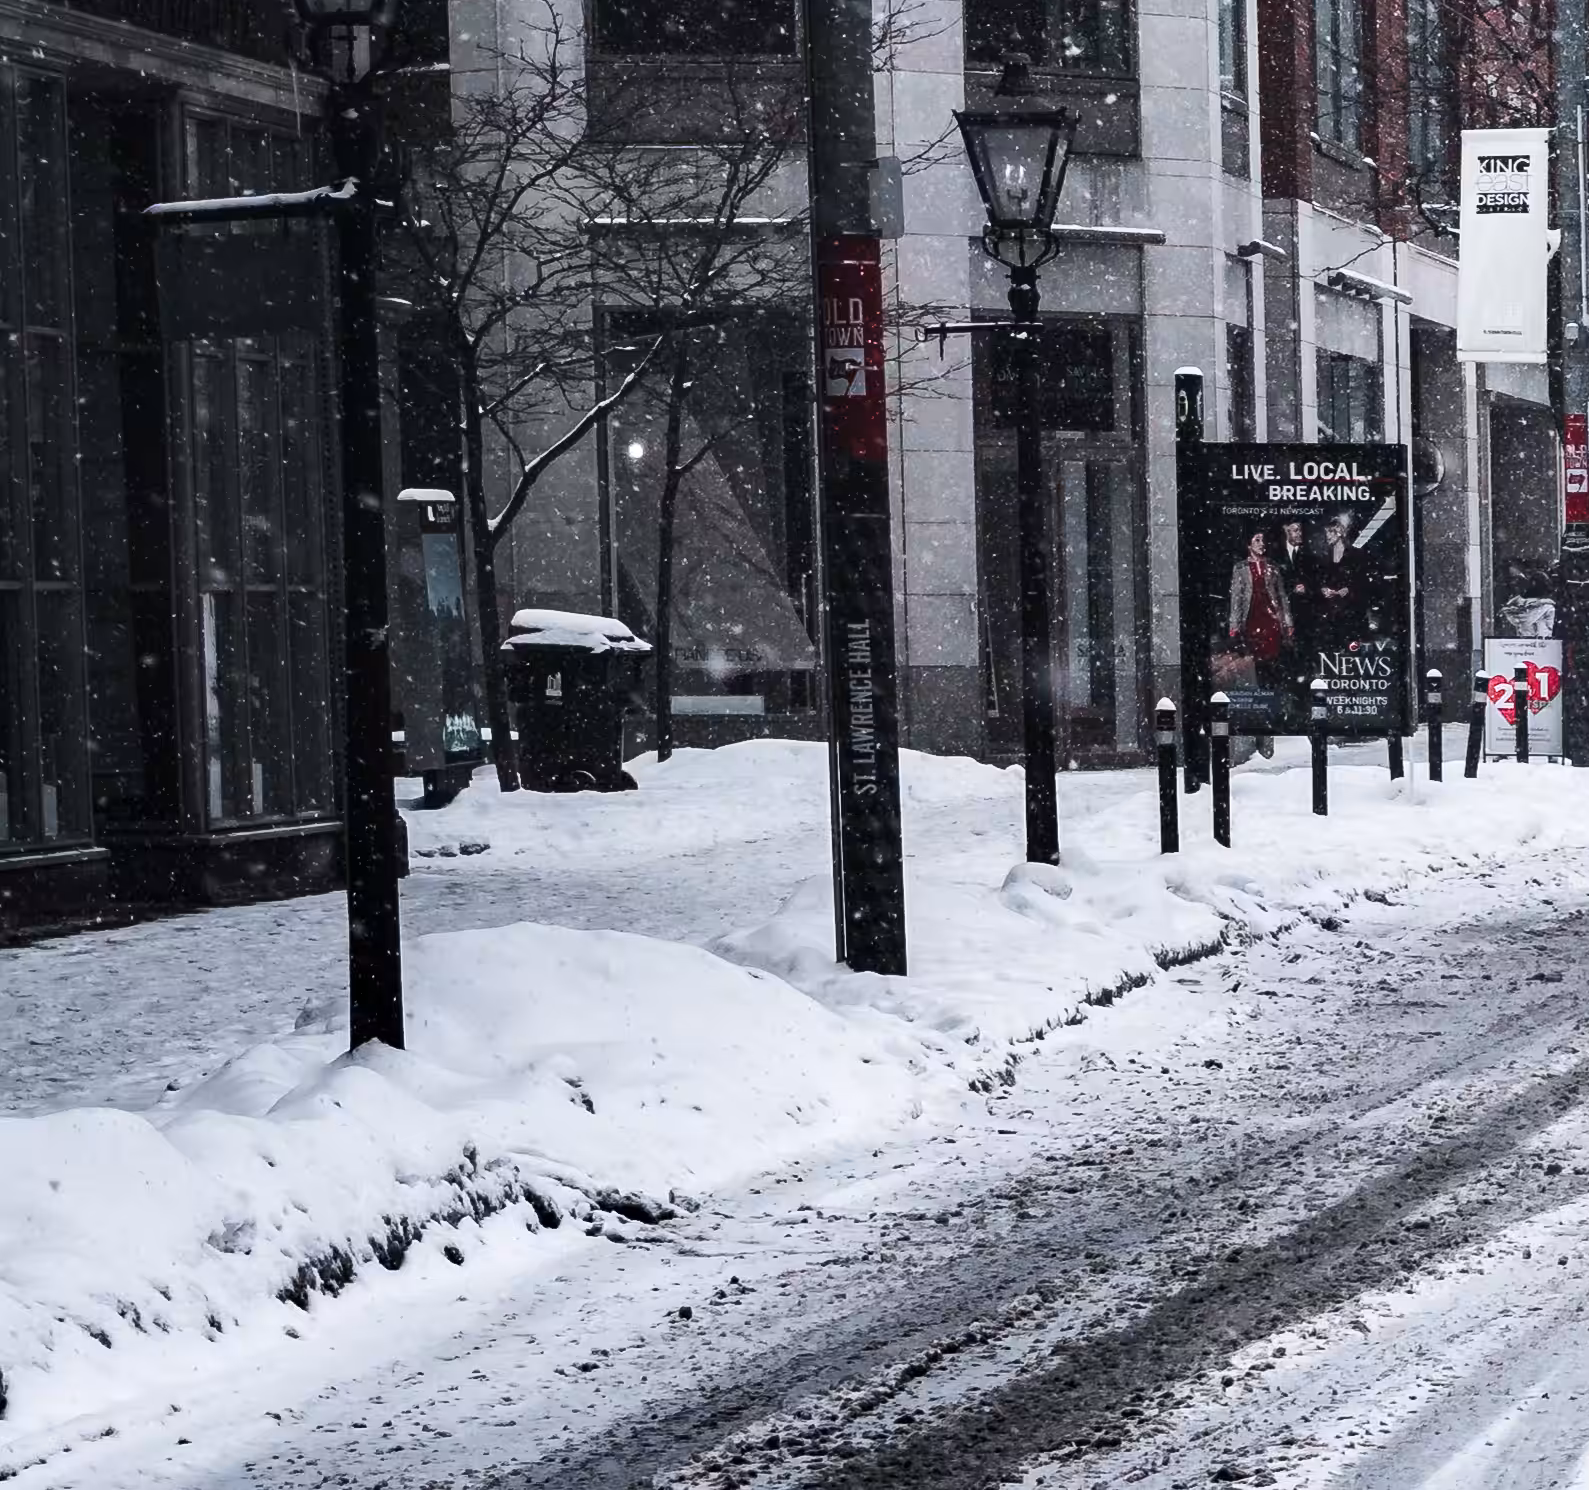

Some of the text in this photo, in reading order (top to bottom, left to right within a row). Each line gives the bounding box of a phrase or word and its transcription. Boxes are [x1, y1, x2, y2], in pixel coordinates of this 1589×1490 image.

[1477, 157, 1531, 174] KING
[1474, 173, 1533, 192] east
[1477, 193, 1531, 206] DESIGN
[1232, 462, 1372, 480] LIVE. LOCAL.
[1269, 485, 1376, 501] BREAKING.
[1222, 506, 1266, 515] TORONTO'S
[1280, 507, 1325, 515] NEWSCAST
[848, 619, 871, 663] HALL
[850, 668, 875, 764] LAWRENCE
[1337, 705, 1343, 714] 6
